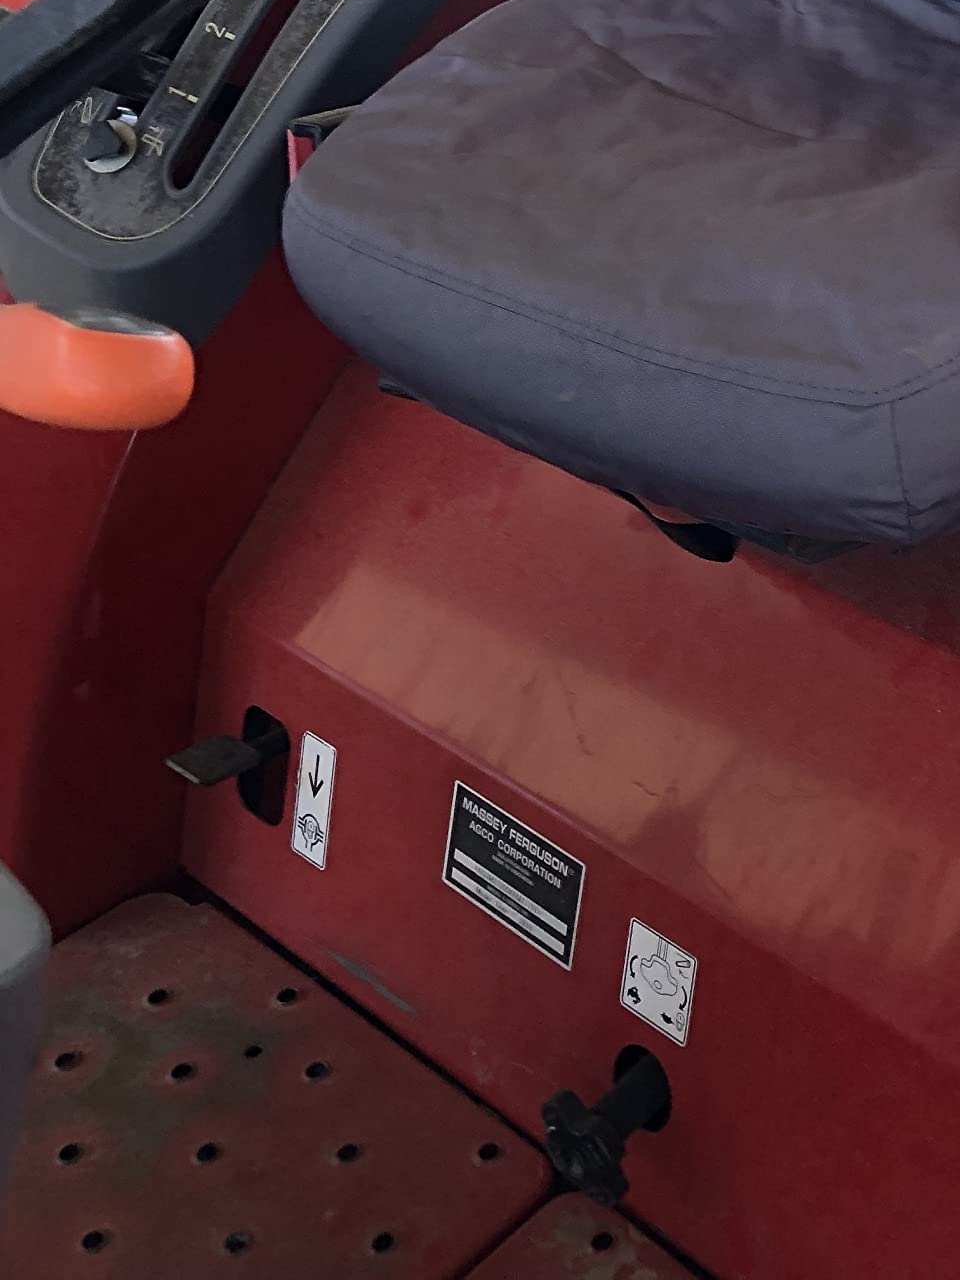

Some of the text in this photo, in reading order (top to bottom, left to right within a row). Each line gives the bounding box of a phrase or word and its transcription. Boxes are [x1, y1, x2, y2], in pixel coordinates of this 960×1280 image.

[204, 21, 227, 39] 2
[462, 796, 508, 835] MASSEY
[469, 820, 494, 843] AGCO
[497, 839, 562, 889] CORPORATION
